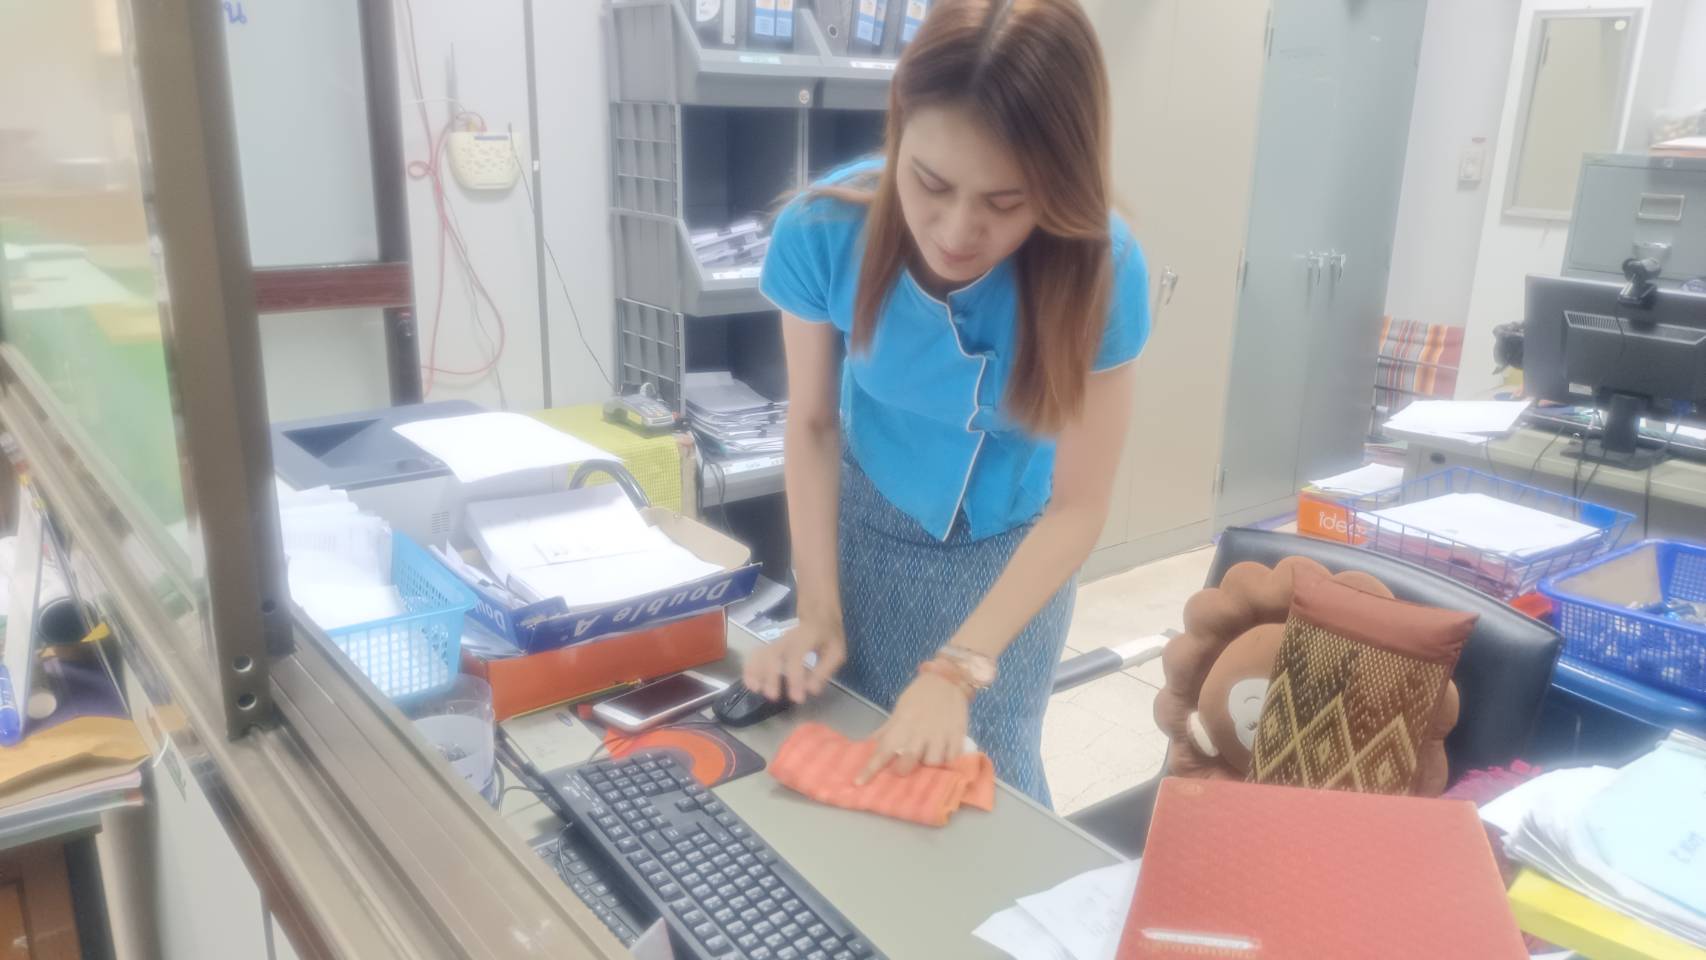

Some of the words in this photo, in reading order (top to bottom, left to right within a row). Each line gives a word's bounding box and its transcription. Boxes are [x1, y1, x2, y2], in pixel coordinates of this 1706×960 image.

[475, 599, 507, 633] Dou
[613, 579, 733, 622] Double
[574, 614, 602, 637] A
